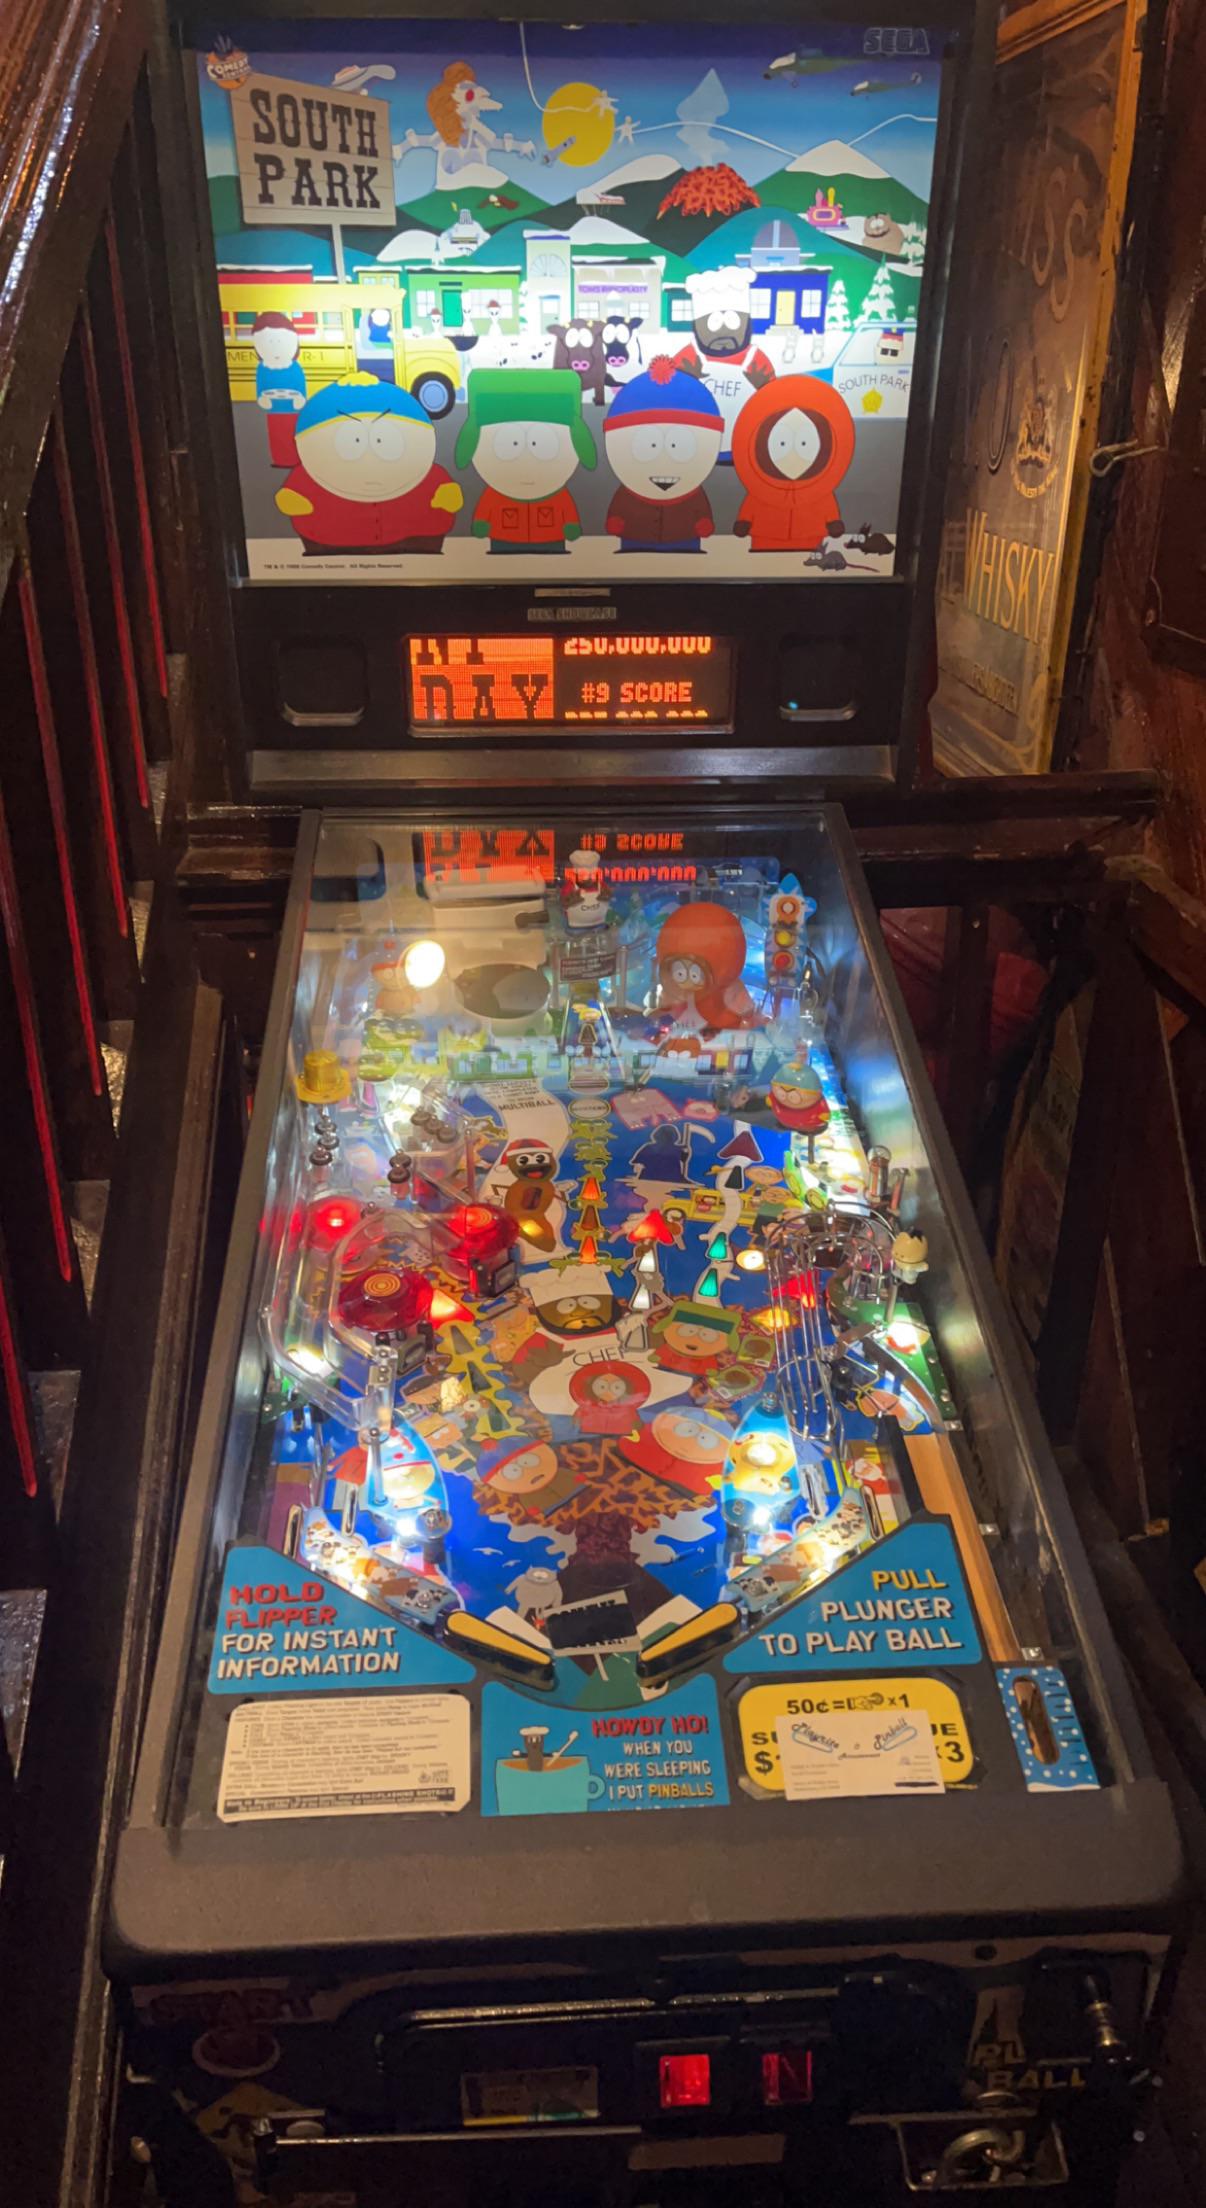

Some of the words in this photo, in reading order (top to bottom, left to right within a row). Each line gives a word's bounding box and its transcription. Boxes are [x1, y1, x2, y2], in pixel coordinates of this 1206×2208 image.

[864, 27, 930, 55] SEGA
[250, 88, 379, 158] SOUTH
[254, 153, 381, 209] PARK
[838, 374, 877, 394] SOUTH
[880, 374, 911, 393] PARK
[964, 508, 1056, 645] WHISKY
[581, 682, 610, 703] #9
[620, 681, 693, 703] SCORE
[498, 1099, 556, 1111] MULTIBALL
[871, 1569, 948, 1592] PULL
[229, 1581, 324, 1606] HOLD
[225, 1605, 338, 1630] FLIPPER
[821, 1597, 952, 1623] PLUNGER
[222, 1632, 275, 1655] FOR
[283, 1626, 397, 1652] INSTANT
[758, 1632, 798, 1657] TO
[805, 1629, 881, 1654] PLAY
[885, 1626, 964, 1652] BALL
[217, 1651, 401, 1680] INFORMATION
[592, 1717, 666, 1738] HOWDY
[671, 1714, 710, 1736] HO!
[623, 1741, 662, 1757] WHEN
[666, 1740, 694, 1756] YOU
[605, 1763, 643, 1779] WERE
[646, 1759, 712, 1778] SLEEPING
[609, 1784, 615, 1801] I
[618, 1783, 644, 1800] PUT
[648, 1781, 715, 1798] PINBALLS
